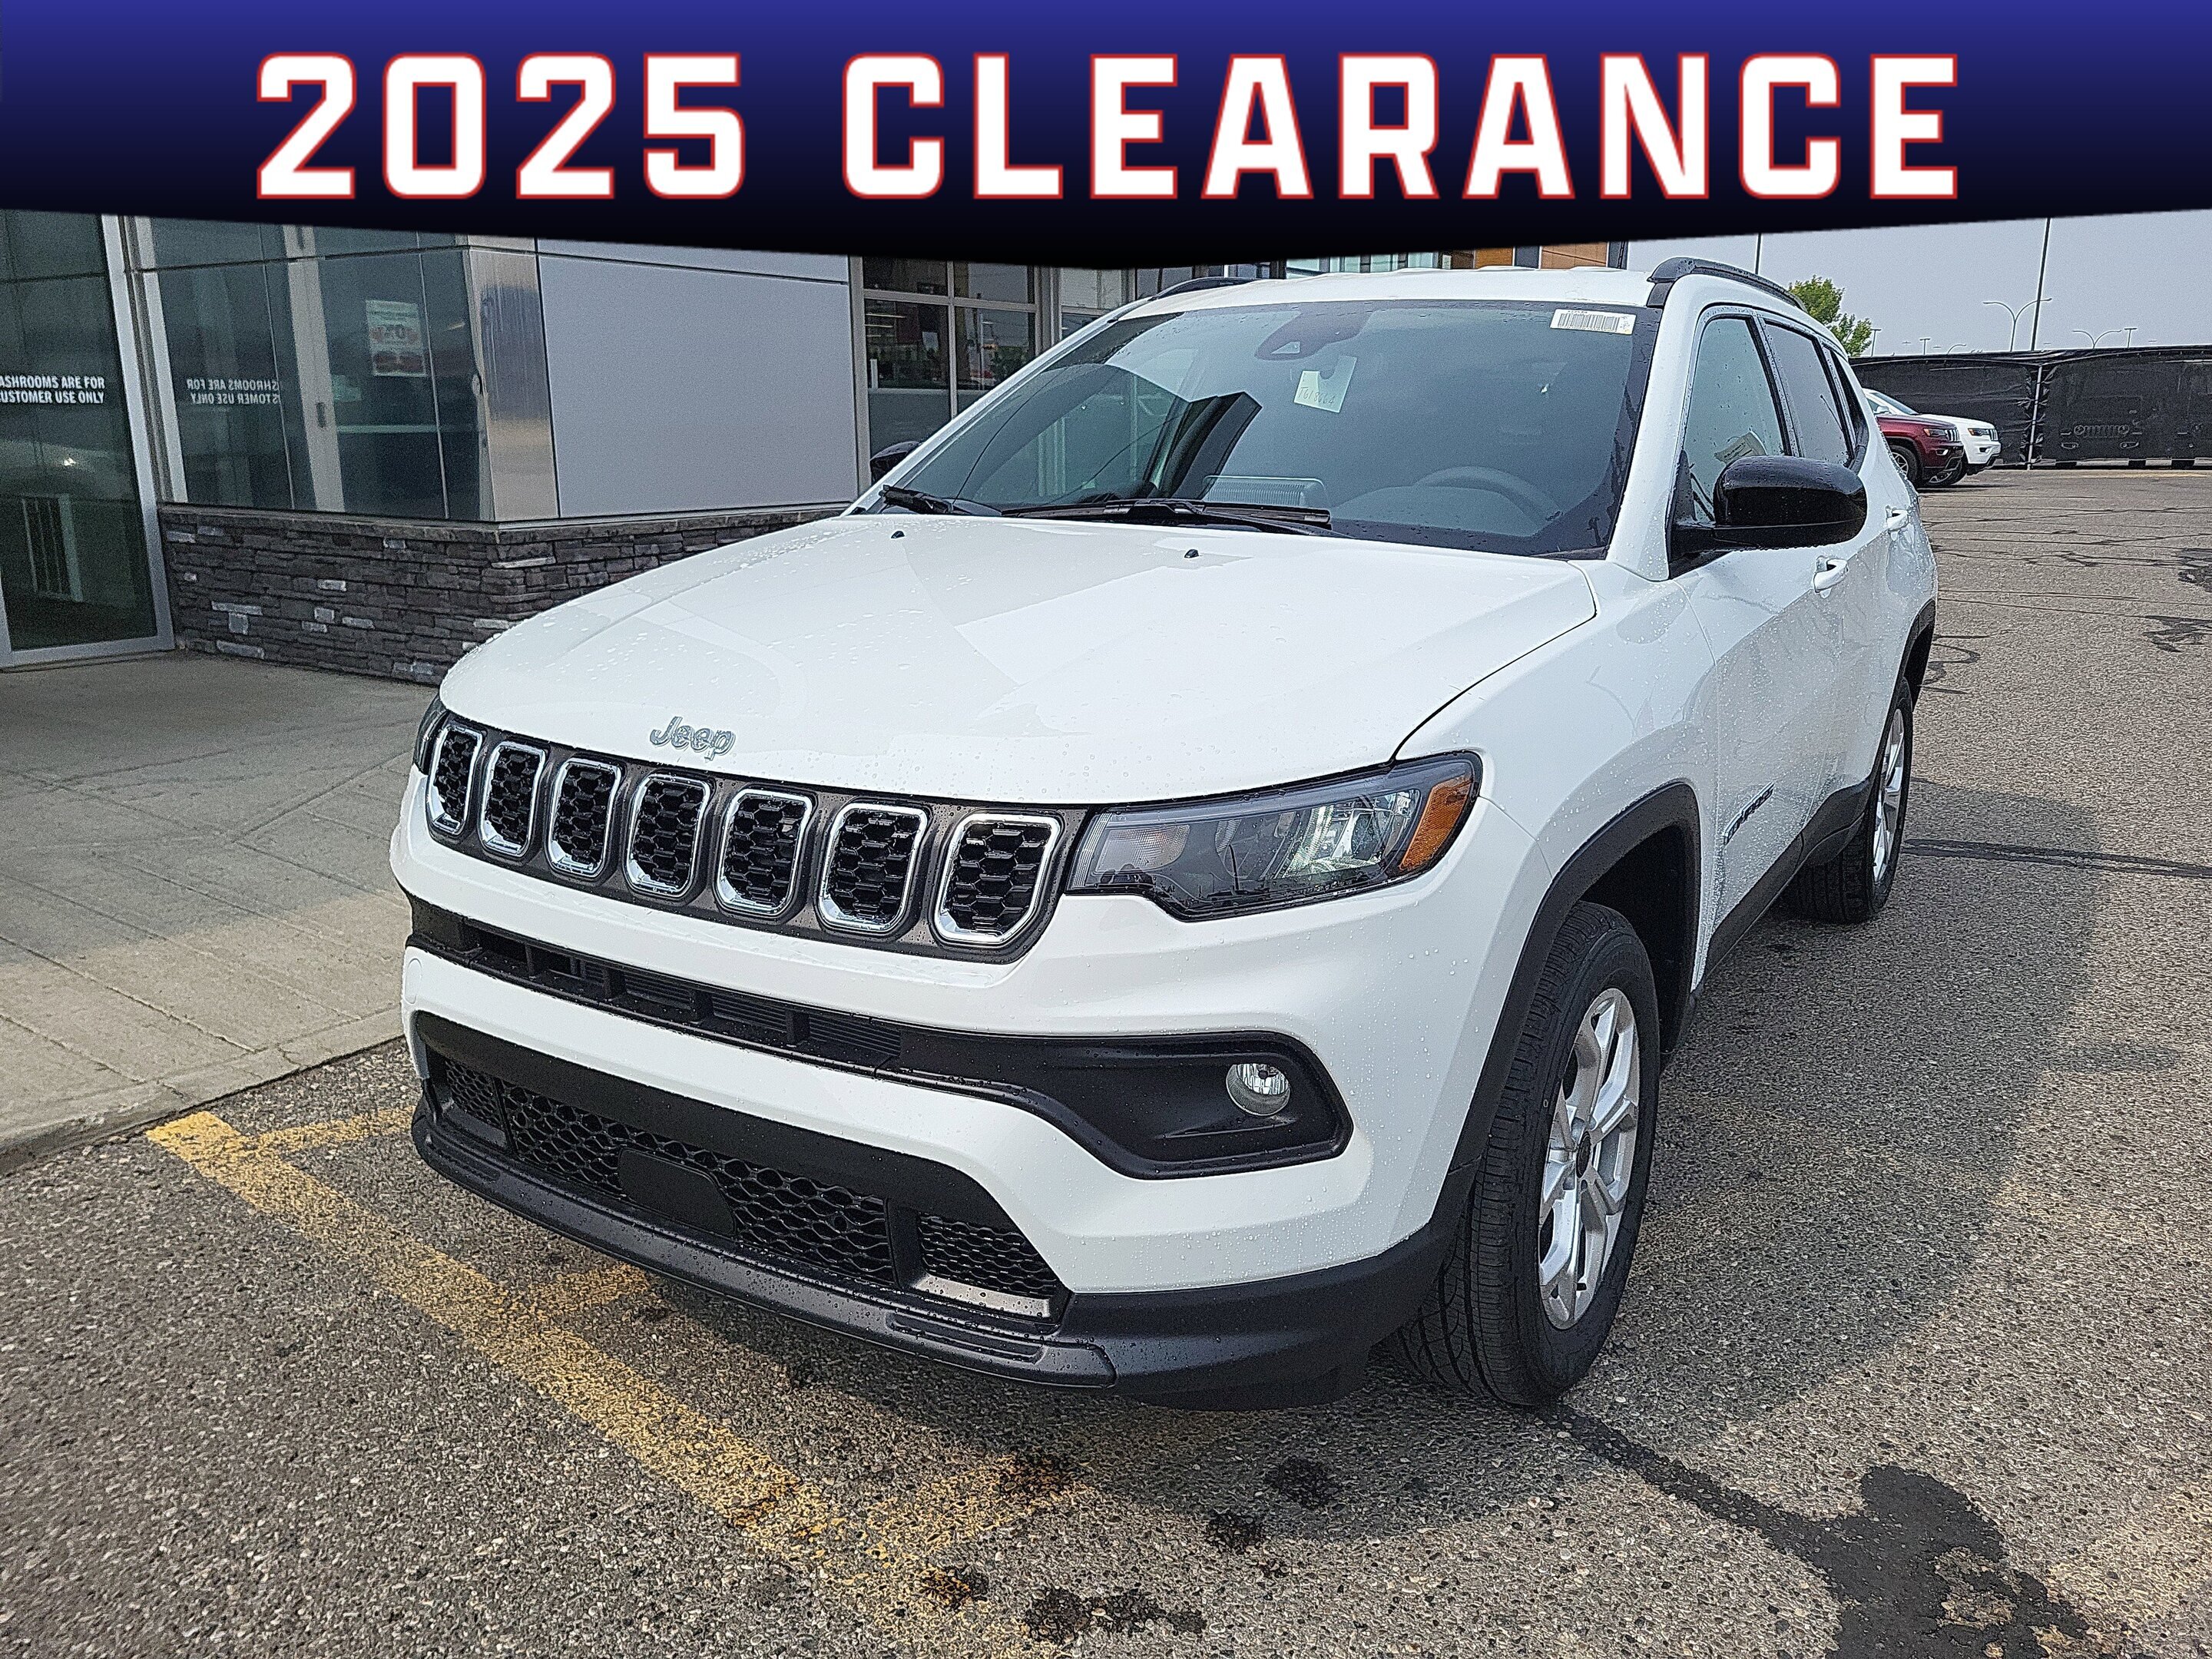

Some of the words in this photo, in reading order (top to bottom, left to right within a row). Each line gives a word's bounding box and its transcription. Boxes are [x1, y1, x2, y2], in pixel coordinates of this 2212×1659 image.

[61, 376, 82, 389] ARE
[84, 376, 105, 389] FOR
[0, 390, 53, 404] USTOMER
[55, 390, 77, 404] USE
[78, 390, 104, 404] ONLY
[649, 716, 736, 761] Jeep
